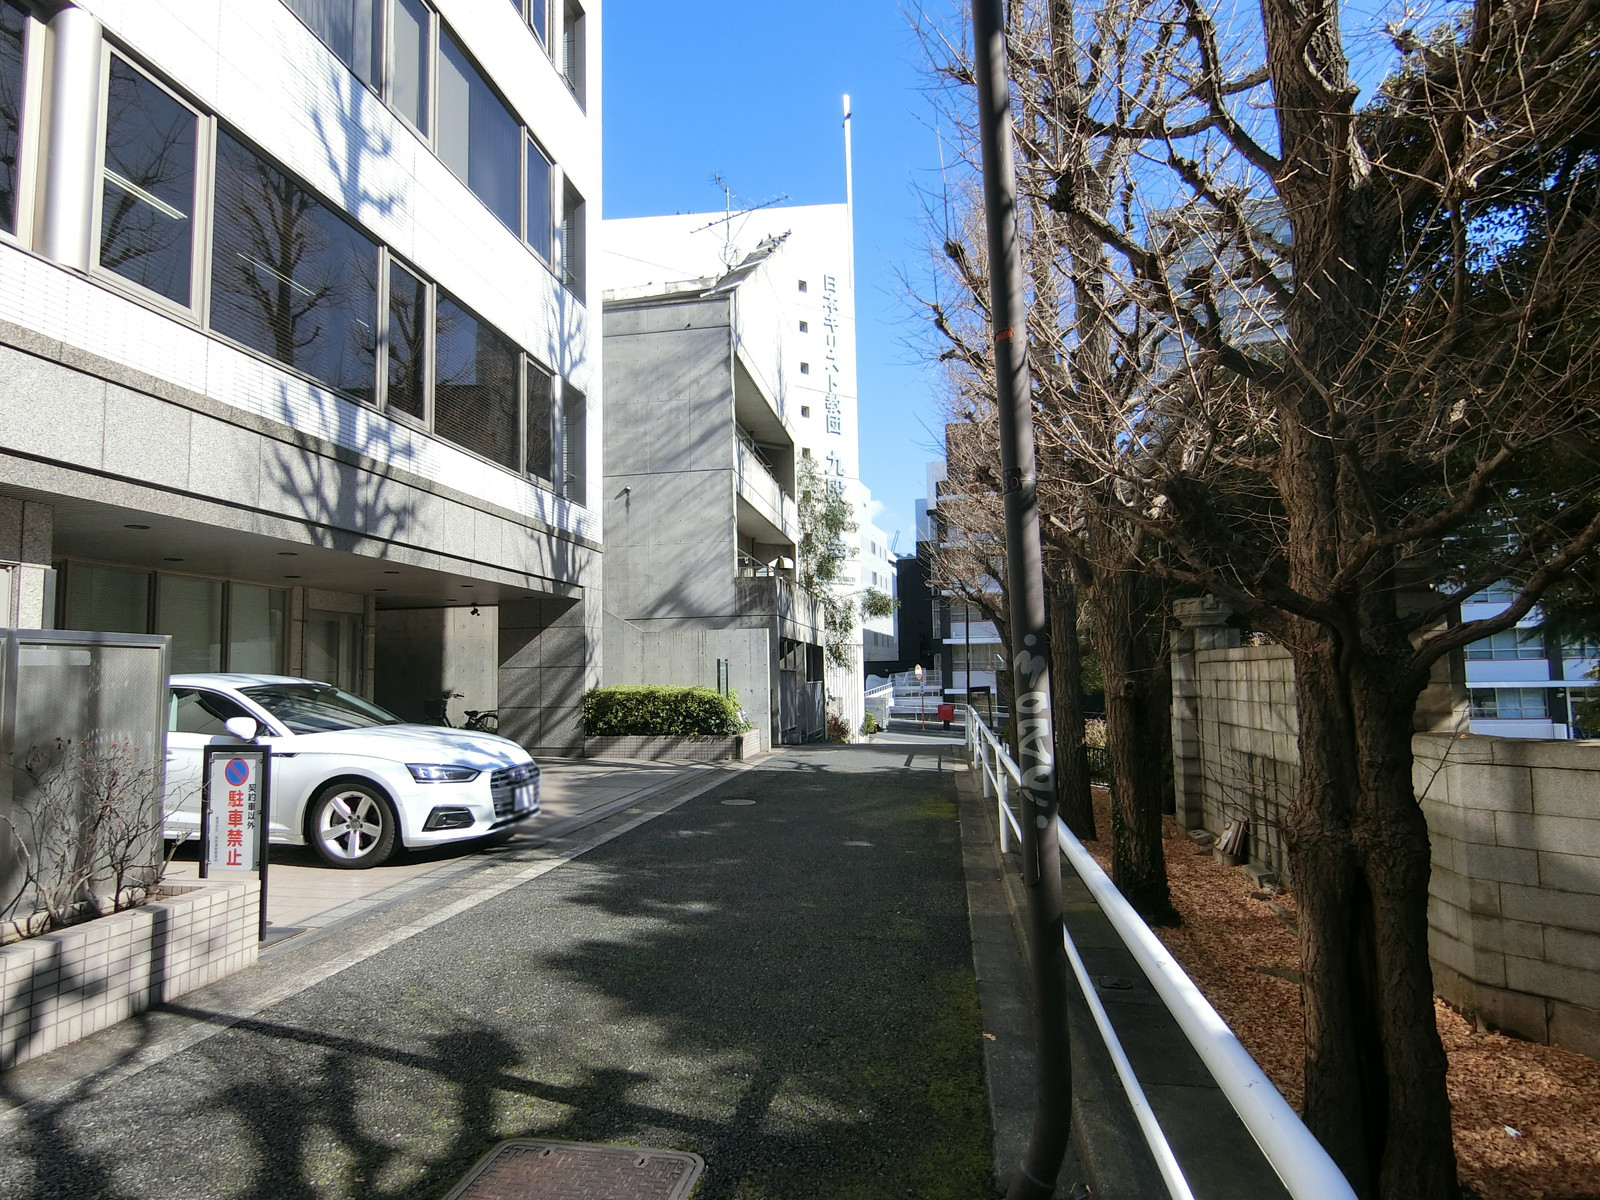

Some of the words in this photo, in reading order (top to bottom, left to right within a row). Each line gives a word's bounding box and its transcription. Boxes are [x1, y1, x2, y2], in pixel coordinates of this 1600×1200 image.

[226, 789, 244, 866] 駐車禁止
[247, 783, 257, 830] 契約車以外
